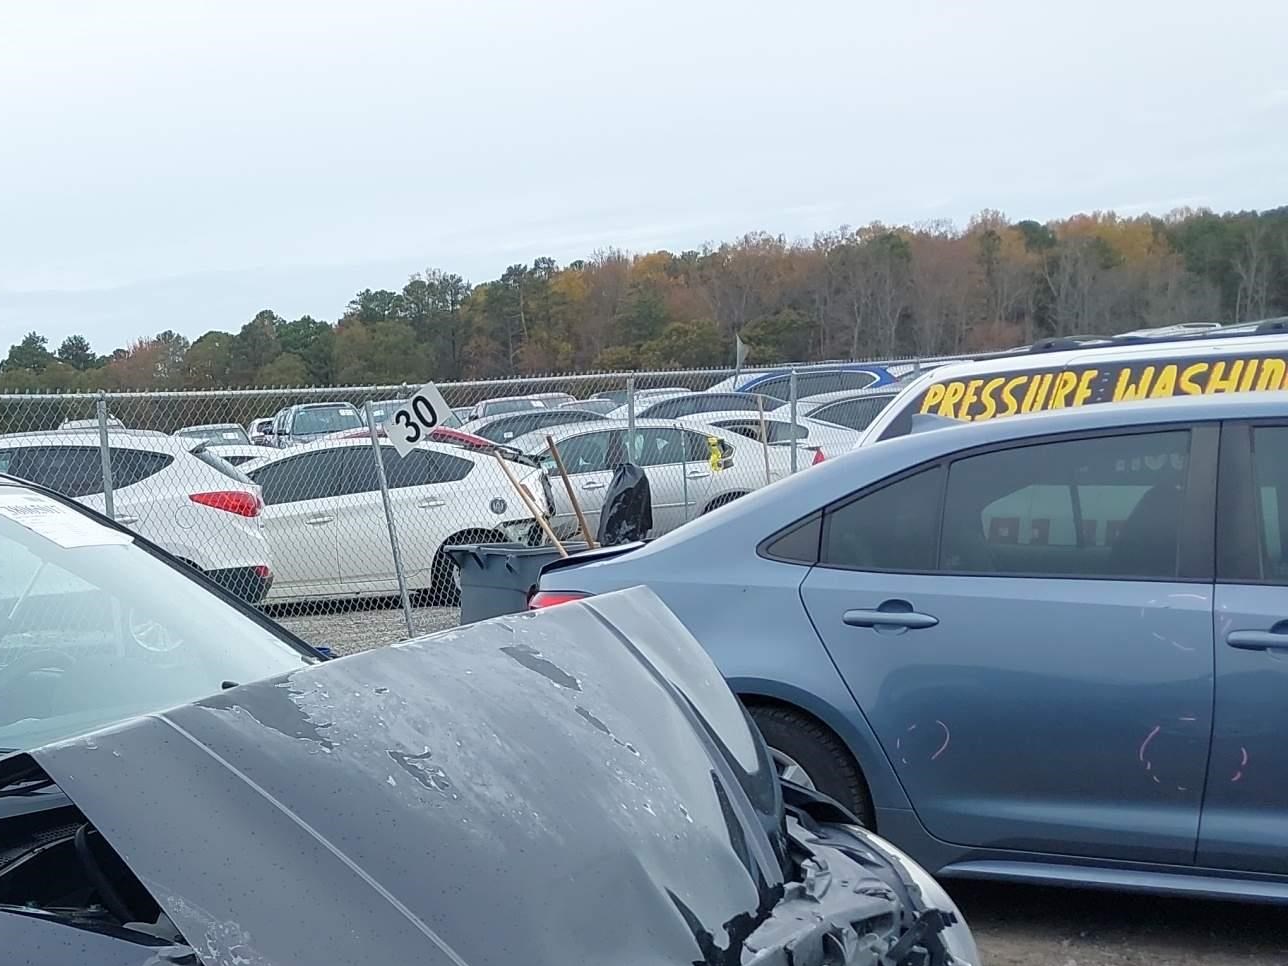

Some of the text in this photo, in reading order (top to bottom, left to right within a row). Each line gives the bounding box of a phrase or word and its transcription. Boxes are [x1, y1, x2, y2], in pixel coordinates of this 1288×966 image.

[920, 358, 1288, 421] PRESSURE WASHIN
[395, 395, 438, 443] 30
